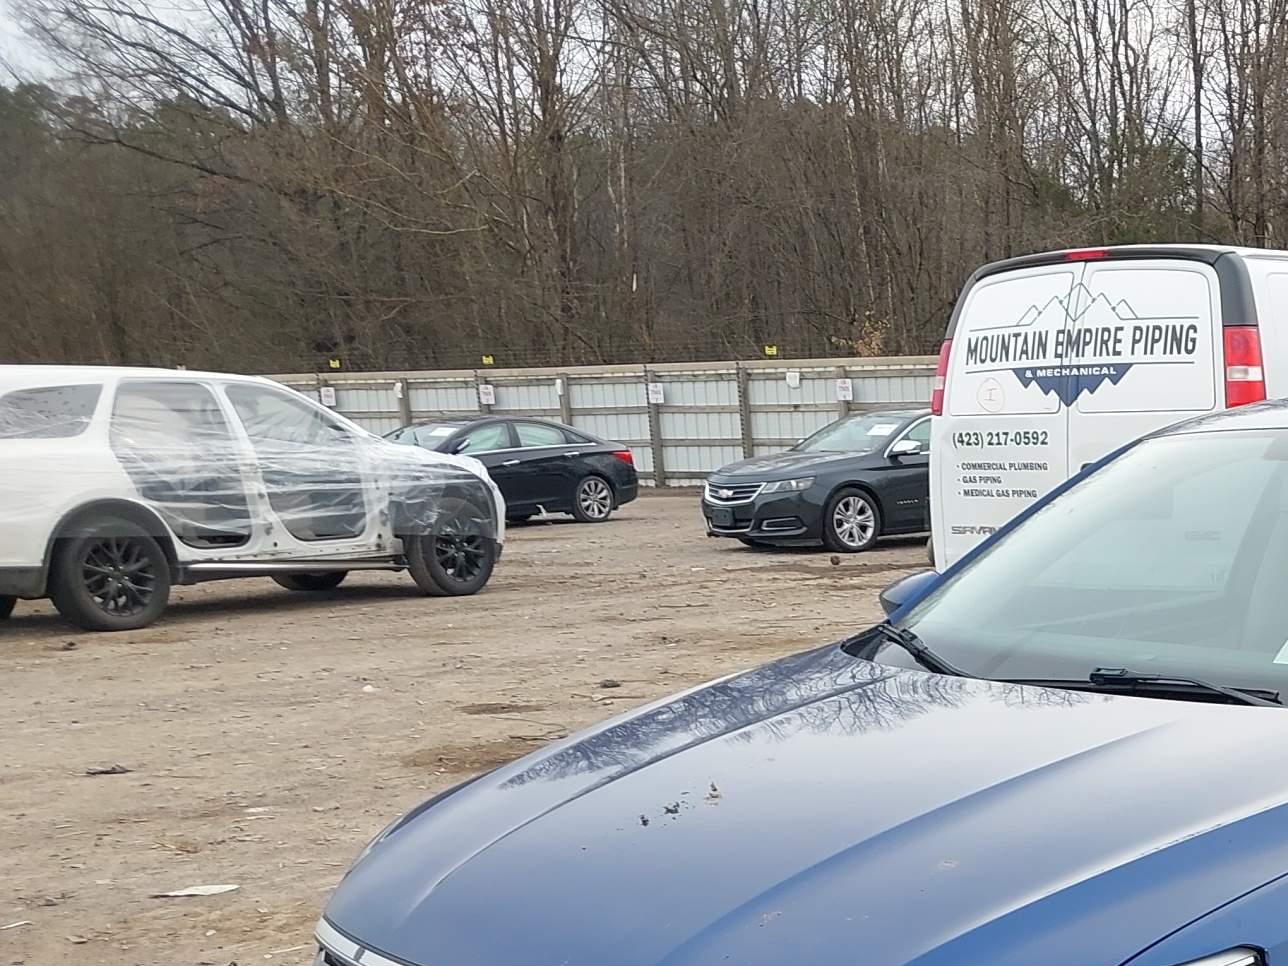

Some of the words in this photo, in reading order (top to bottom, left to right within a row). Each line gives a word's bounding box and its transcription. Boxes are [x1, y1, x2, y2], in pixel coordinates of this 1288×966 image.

[966, 329, 1049, 366] MOUNTAIN
[1054, 326, 1124, 359] EMPIRE
[1131, 324, 1198, 356] PIPING
[1025, 369, 1033, 378] &
[1036, 366, 1117, 378] MECHANICAL
[952, 432, 984, 449] (423)
[986, 431, 1049, 446] 217-0592
[961, 462, 1008, 471] COMMERCIAL
[1008, 462, 1048, 471] PLUMBING
[962, 475, 977, 484] GAS
[978, 475, 1002, 484] PIPING
[963, 488, 995, 498] MEDICAL
[995, 489, 1010, 498] GAS
[1011, 489, 1038, 498] PIPING
